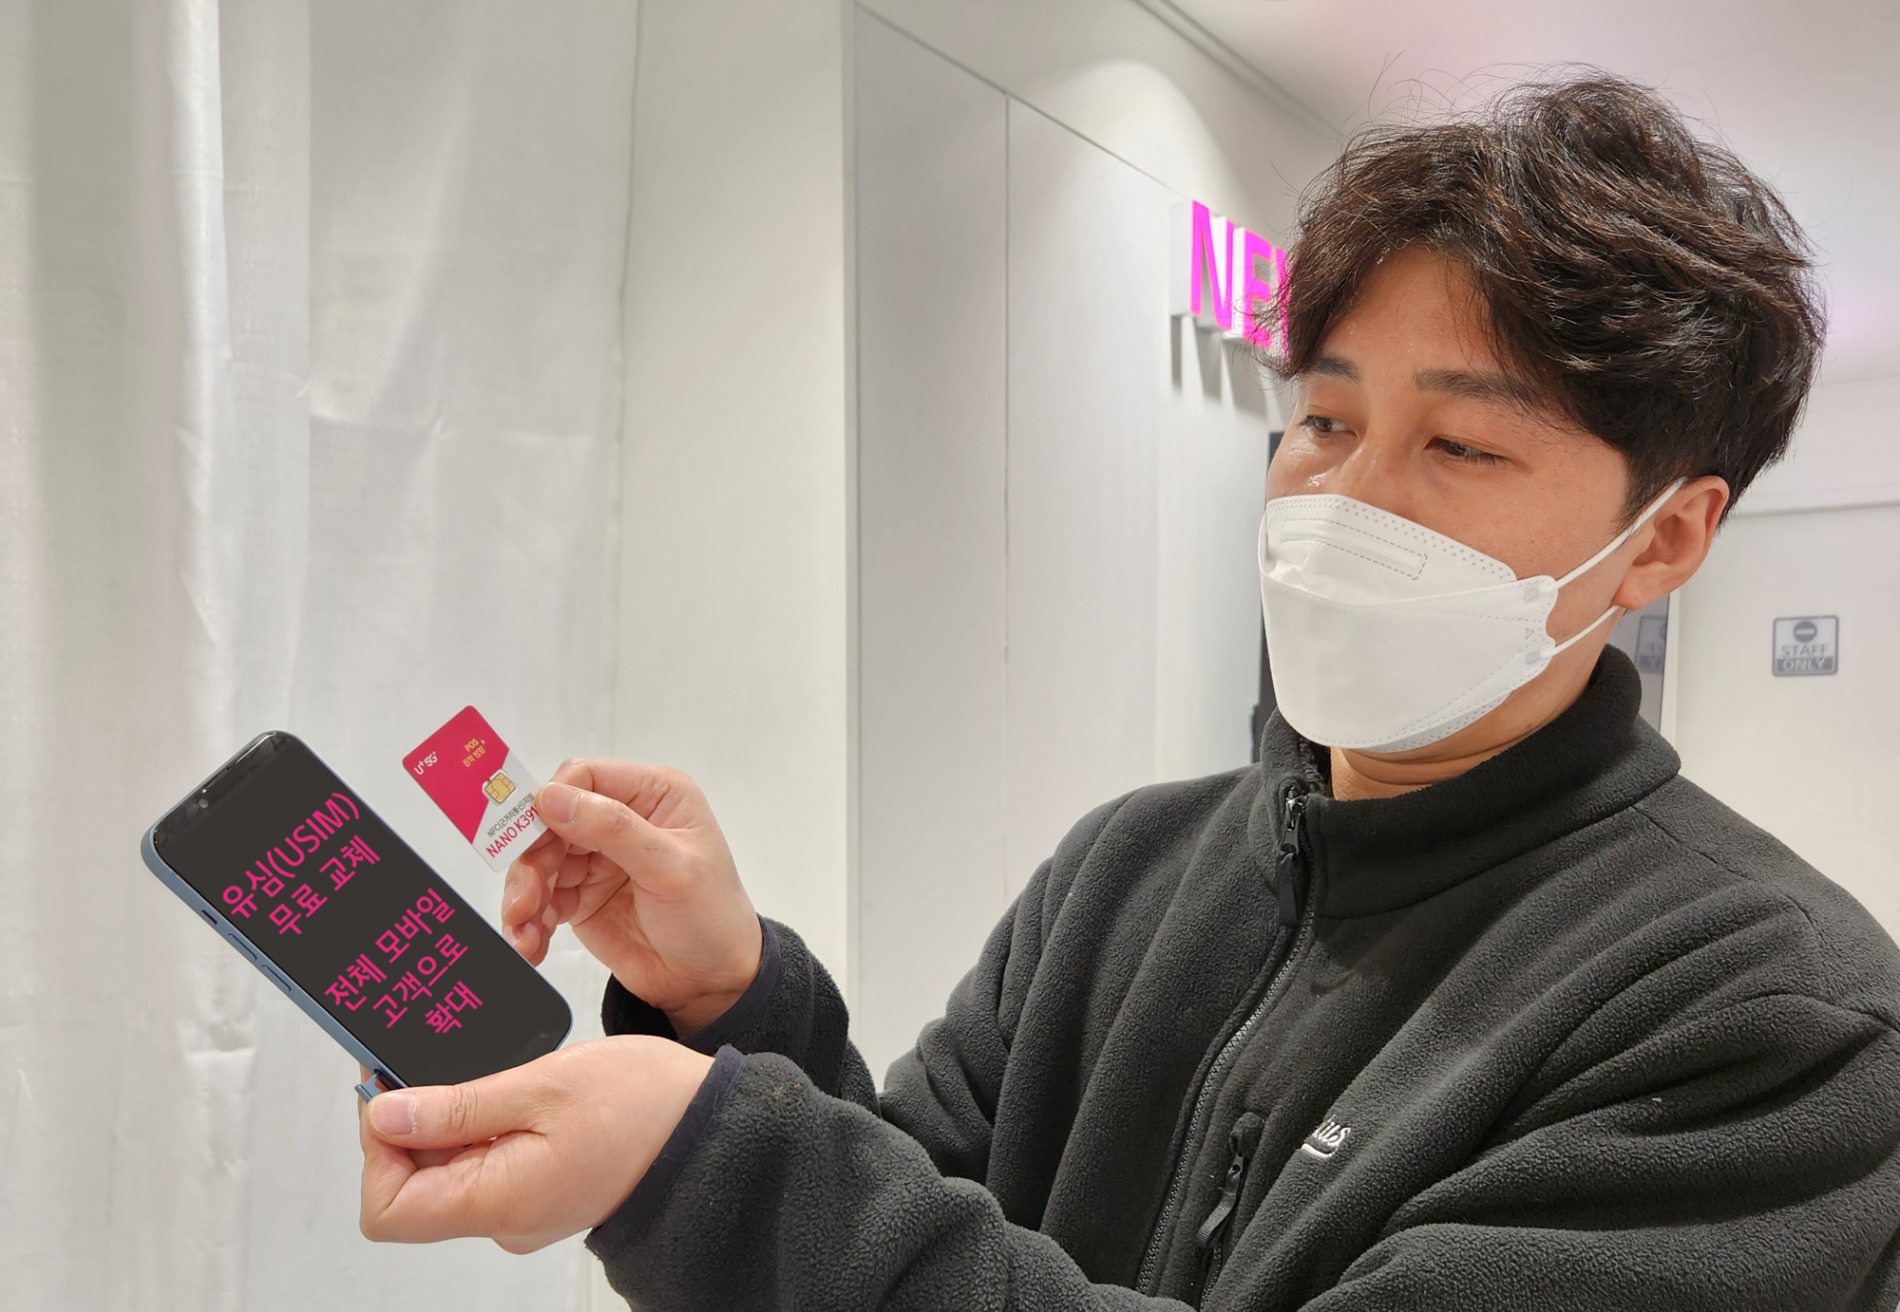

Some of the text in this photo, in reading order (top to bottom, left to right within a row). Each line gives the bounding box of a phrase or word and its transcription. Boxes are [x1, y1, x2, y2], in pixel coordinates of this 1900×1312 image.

[1781, 643, 1829, 657] STAFF
[1782, 656, 1826, 671] ONLY
[464, 738, 479, 752] POS
[222, 792, 360, 919] 유심(USIM)
[485, 826, 518, 858] NANO
[268, 835, 381, 935] 무료 교체
[324, 887, 456, 1012] 전체 모바일
[372, 933, 469, 1029] 고객으로
[424, 980, 484, 1034] 확대
